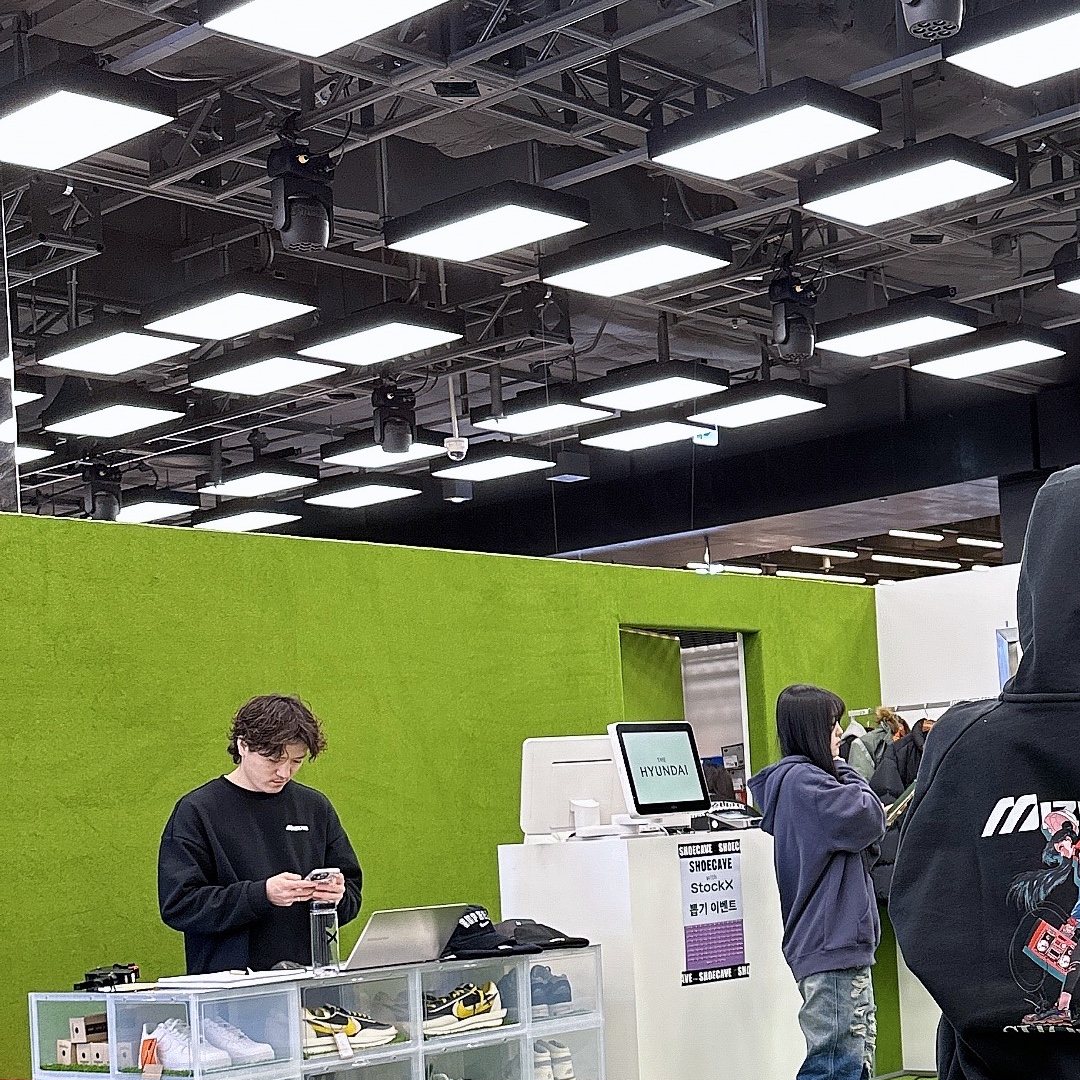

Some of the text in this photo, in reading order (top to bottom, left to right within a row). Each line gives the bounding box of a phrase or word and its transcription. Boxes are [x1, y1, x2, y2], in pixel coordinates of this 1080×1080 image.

[639, 765, 689, 777] HYUNDAI
[679, 844, 713, 856] SHOECAVE
[689, 858, 733, 873] SHOECAVE
[690, 879, 734, 893] StockX
[689, 899, 738, 917] 뽑기 이벤트
[698, 968, 732, 982] SHOECAVE
